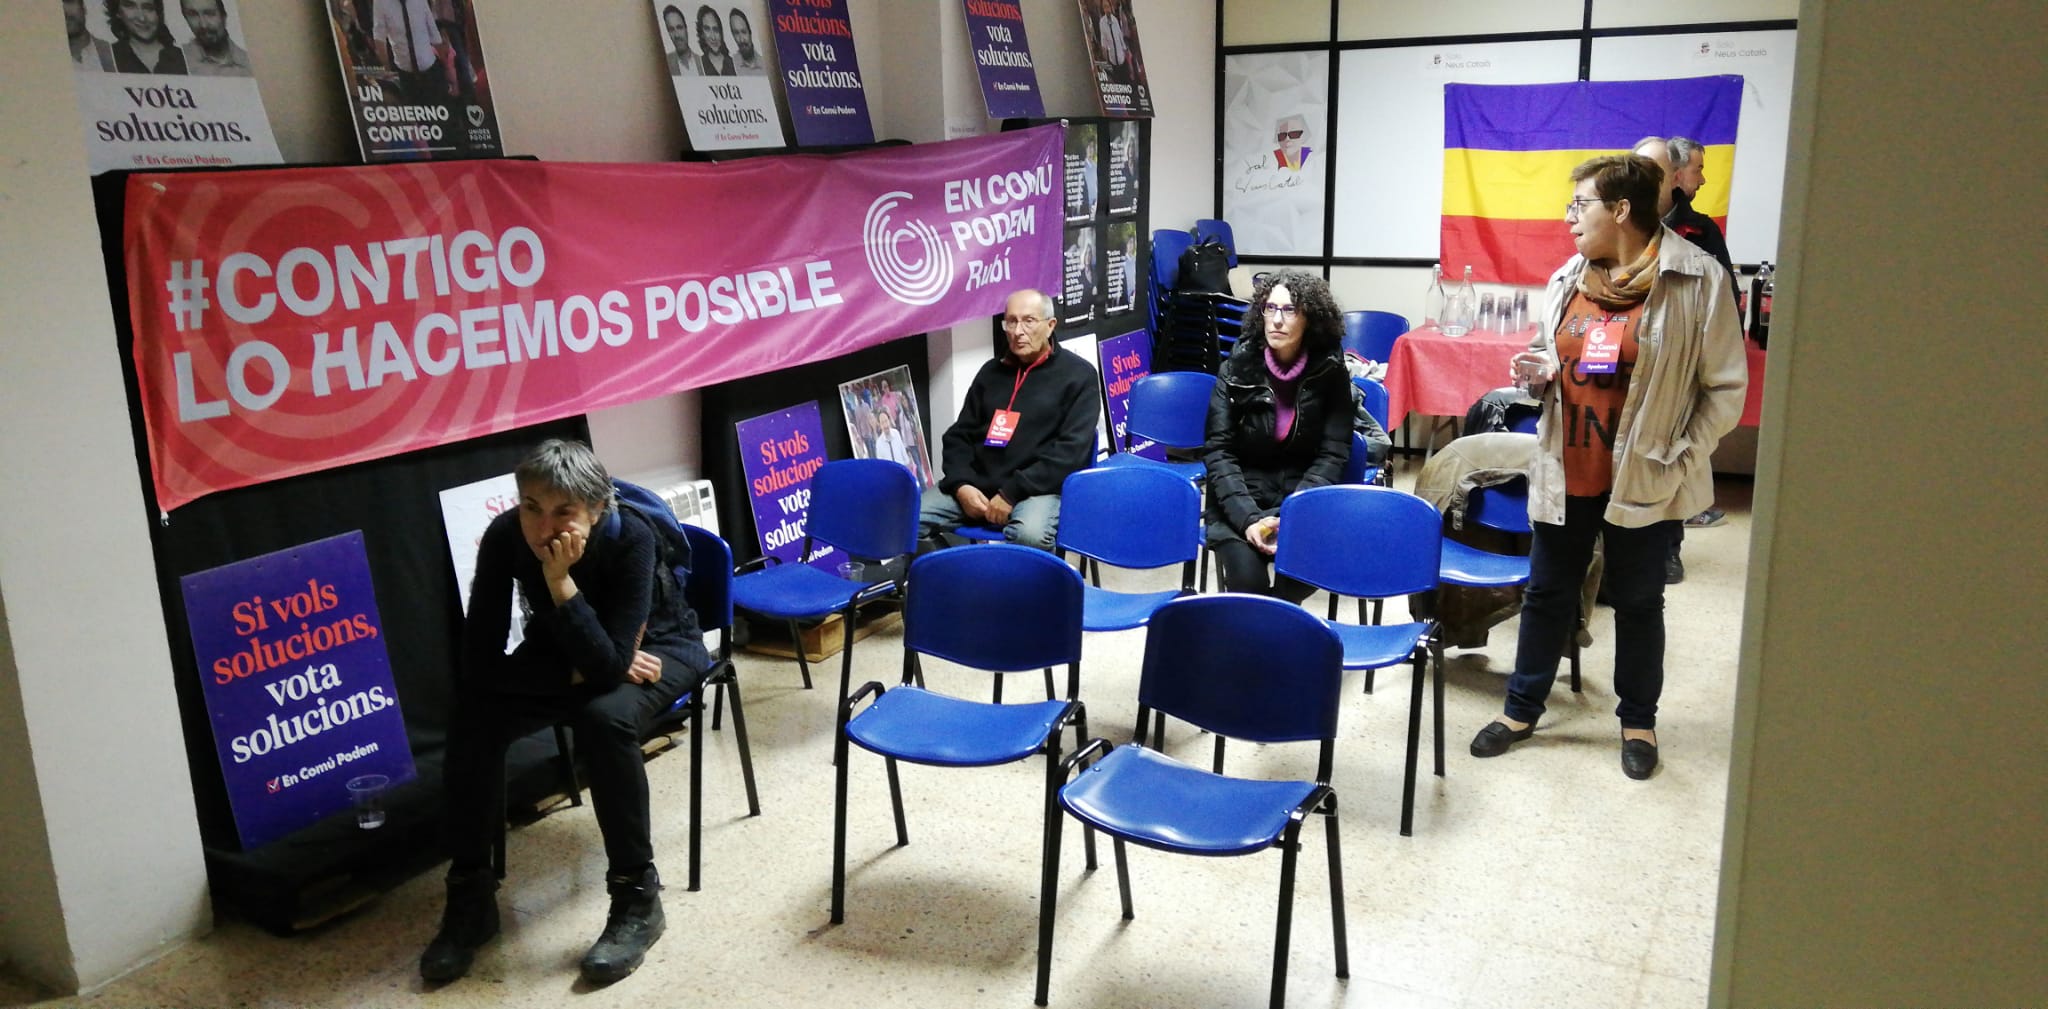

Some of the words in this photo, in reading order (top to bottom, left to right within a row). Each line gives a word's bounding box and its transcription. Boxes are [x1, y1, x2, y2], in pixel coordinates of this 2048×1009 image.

[777, 9, 851, 39] solucions,
[985, 24, 1012, 43] vota
[801, 42, 836, 62] vota
[978, 44, 1032, 69] solucions.
[788, 64, 861, 89] solucions.
[1101, 83, 1133, 94] GOBIERNO
[124, 84, 197, 109] vota
[358, 84, 384, 102] UN
[709, 83, 743, 101] vota
[1103, 94, 1132, 105] CONTIGO
[96, 112, 252, 142] solucions.
[363, 105, 449, 122] GOBIERNO
[698, 103, 768, 126] solucions.
[367, 124, 443, 143] CONTIGO
[945, 178, 984, 214] EN
[987, 155, 1053, 205] COMÚ
[950, 205, 1035, 251] PODEM
[166, 226, 546, 333] #CONTIGO
[965, 247, 1011, 292] Rubí
[173, 340, 291, 423] LO
[311, 290, 633, 398] HACEMOS
[645, 260, 844, 340] POSIBLE
[1112, 355, 1123, 375] Si
[1122, 350, 1141, 371] vols
[760, 438, 779, 465] Si
[778, 430, 809, 459] vols
[778, 488, 811, 515] vota
[232, 596, 269, 636] Si
[270, 578, 338, 623] vols
[213, 613, 378, 684] solucions,
[265, 663, 342, 706] vota
[231, 685, 394, 763] solucions.
[282, 772, 299, 788] En
[299, 755, 336, 782] Comú
[336, 742, 379, 766] Podem
